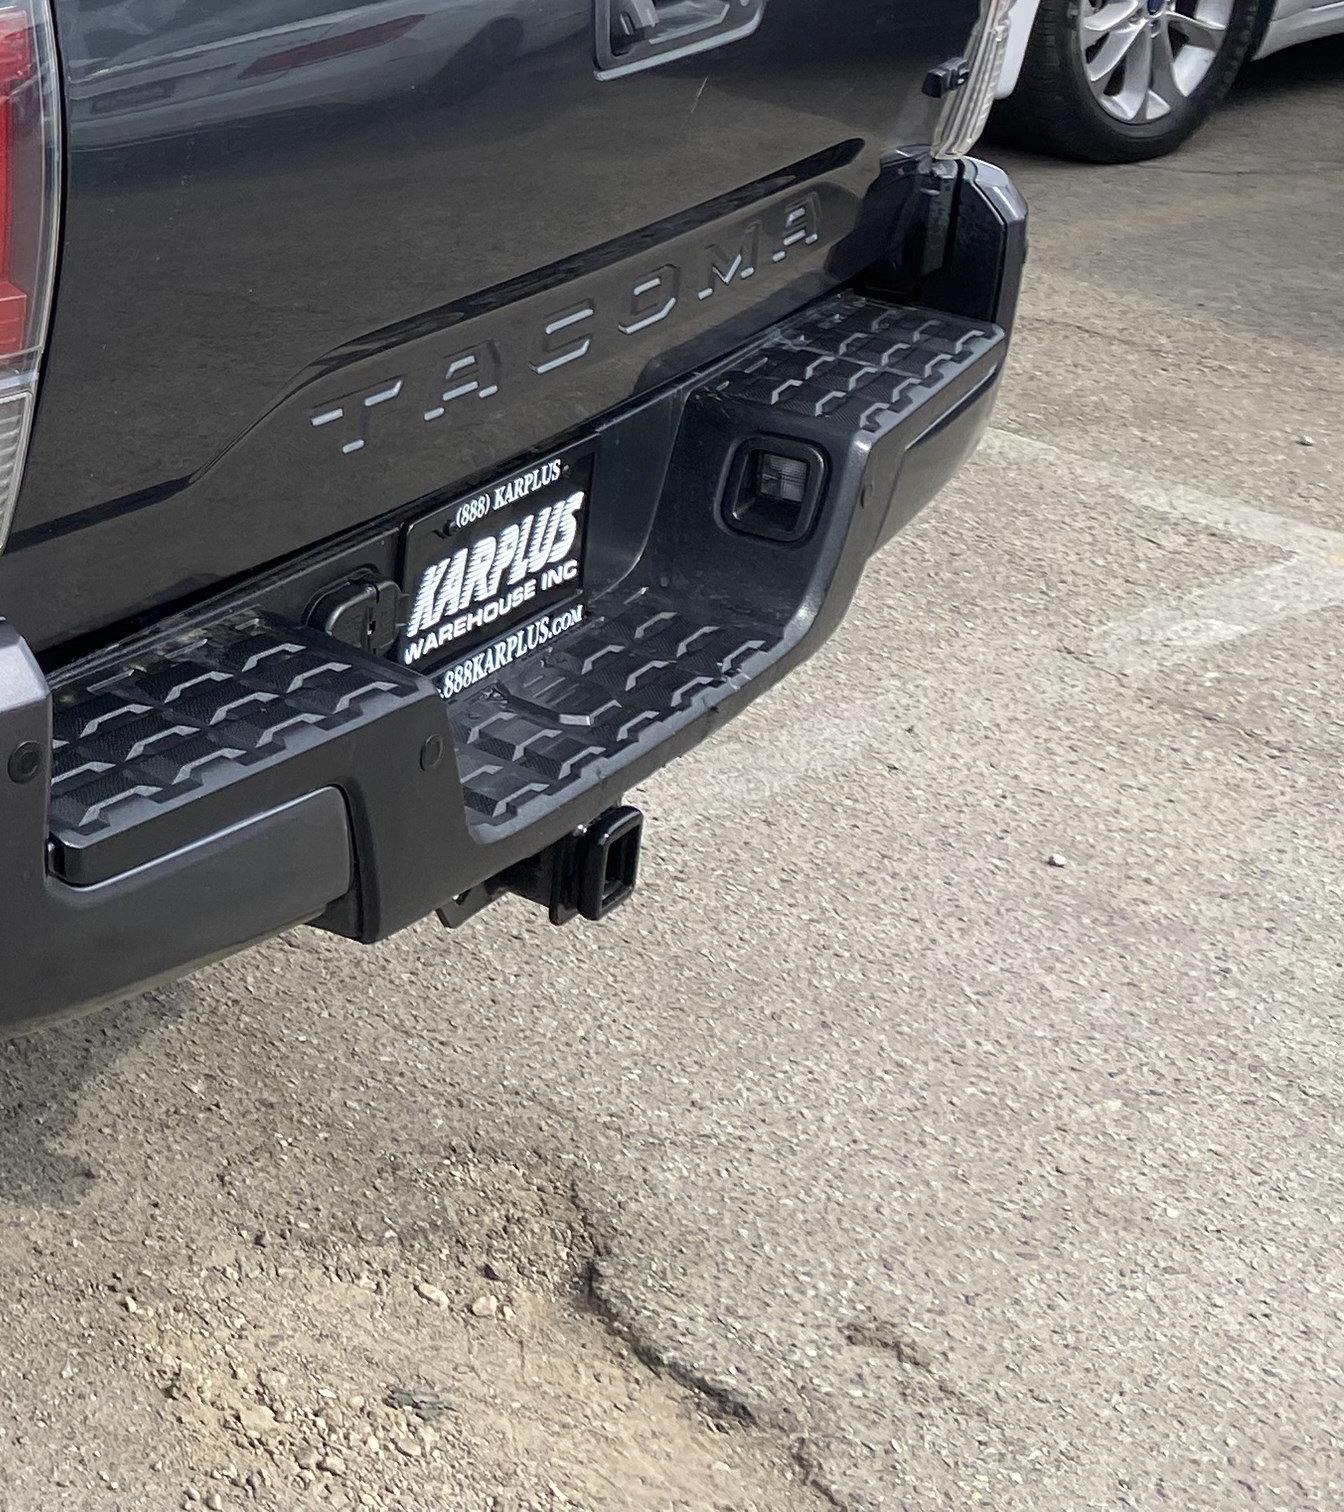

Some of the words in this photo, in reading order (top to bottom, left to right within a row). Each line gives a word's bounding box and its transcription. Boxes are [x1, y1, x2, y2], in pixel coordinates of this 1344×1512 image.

[311, 191, 824, 455] TACOMA
[455, 494, 491, 528] (888)
[493, 458, 562, 510] KARPLUS
[404, 579, 538, 665] WAREHOUSE
[540, 559, 579, 591] INC
[406, 491, 585, 637] KARPLUS
